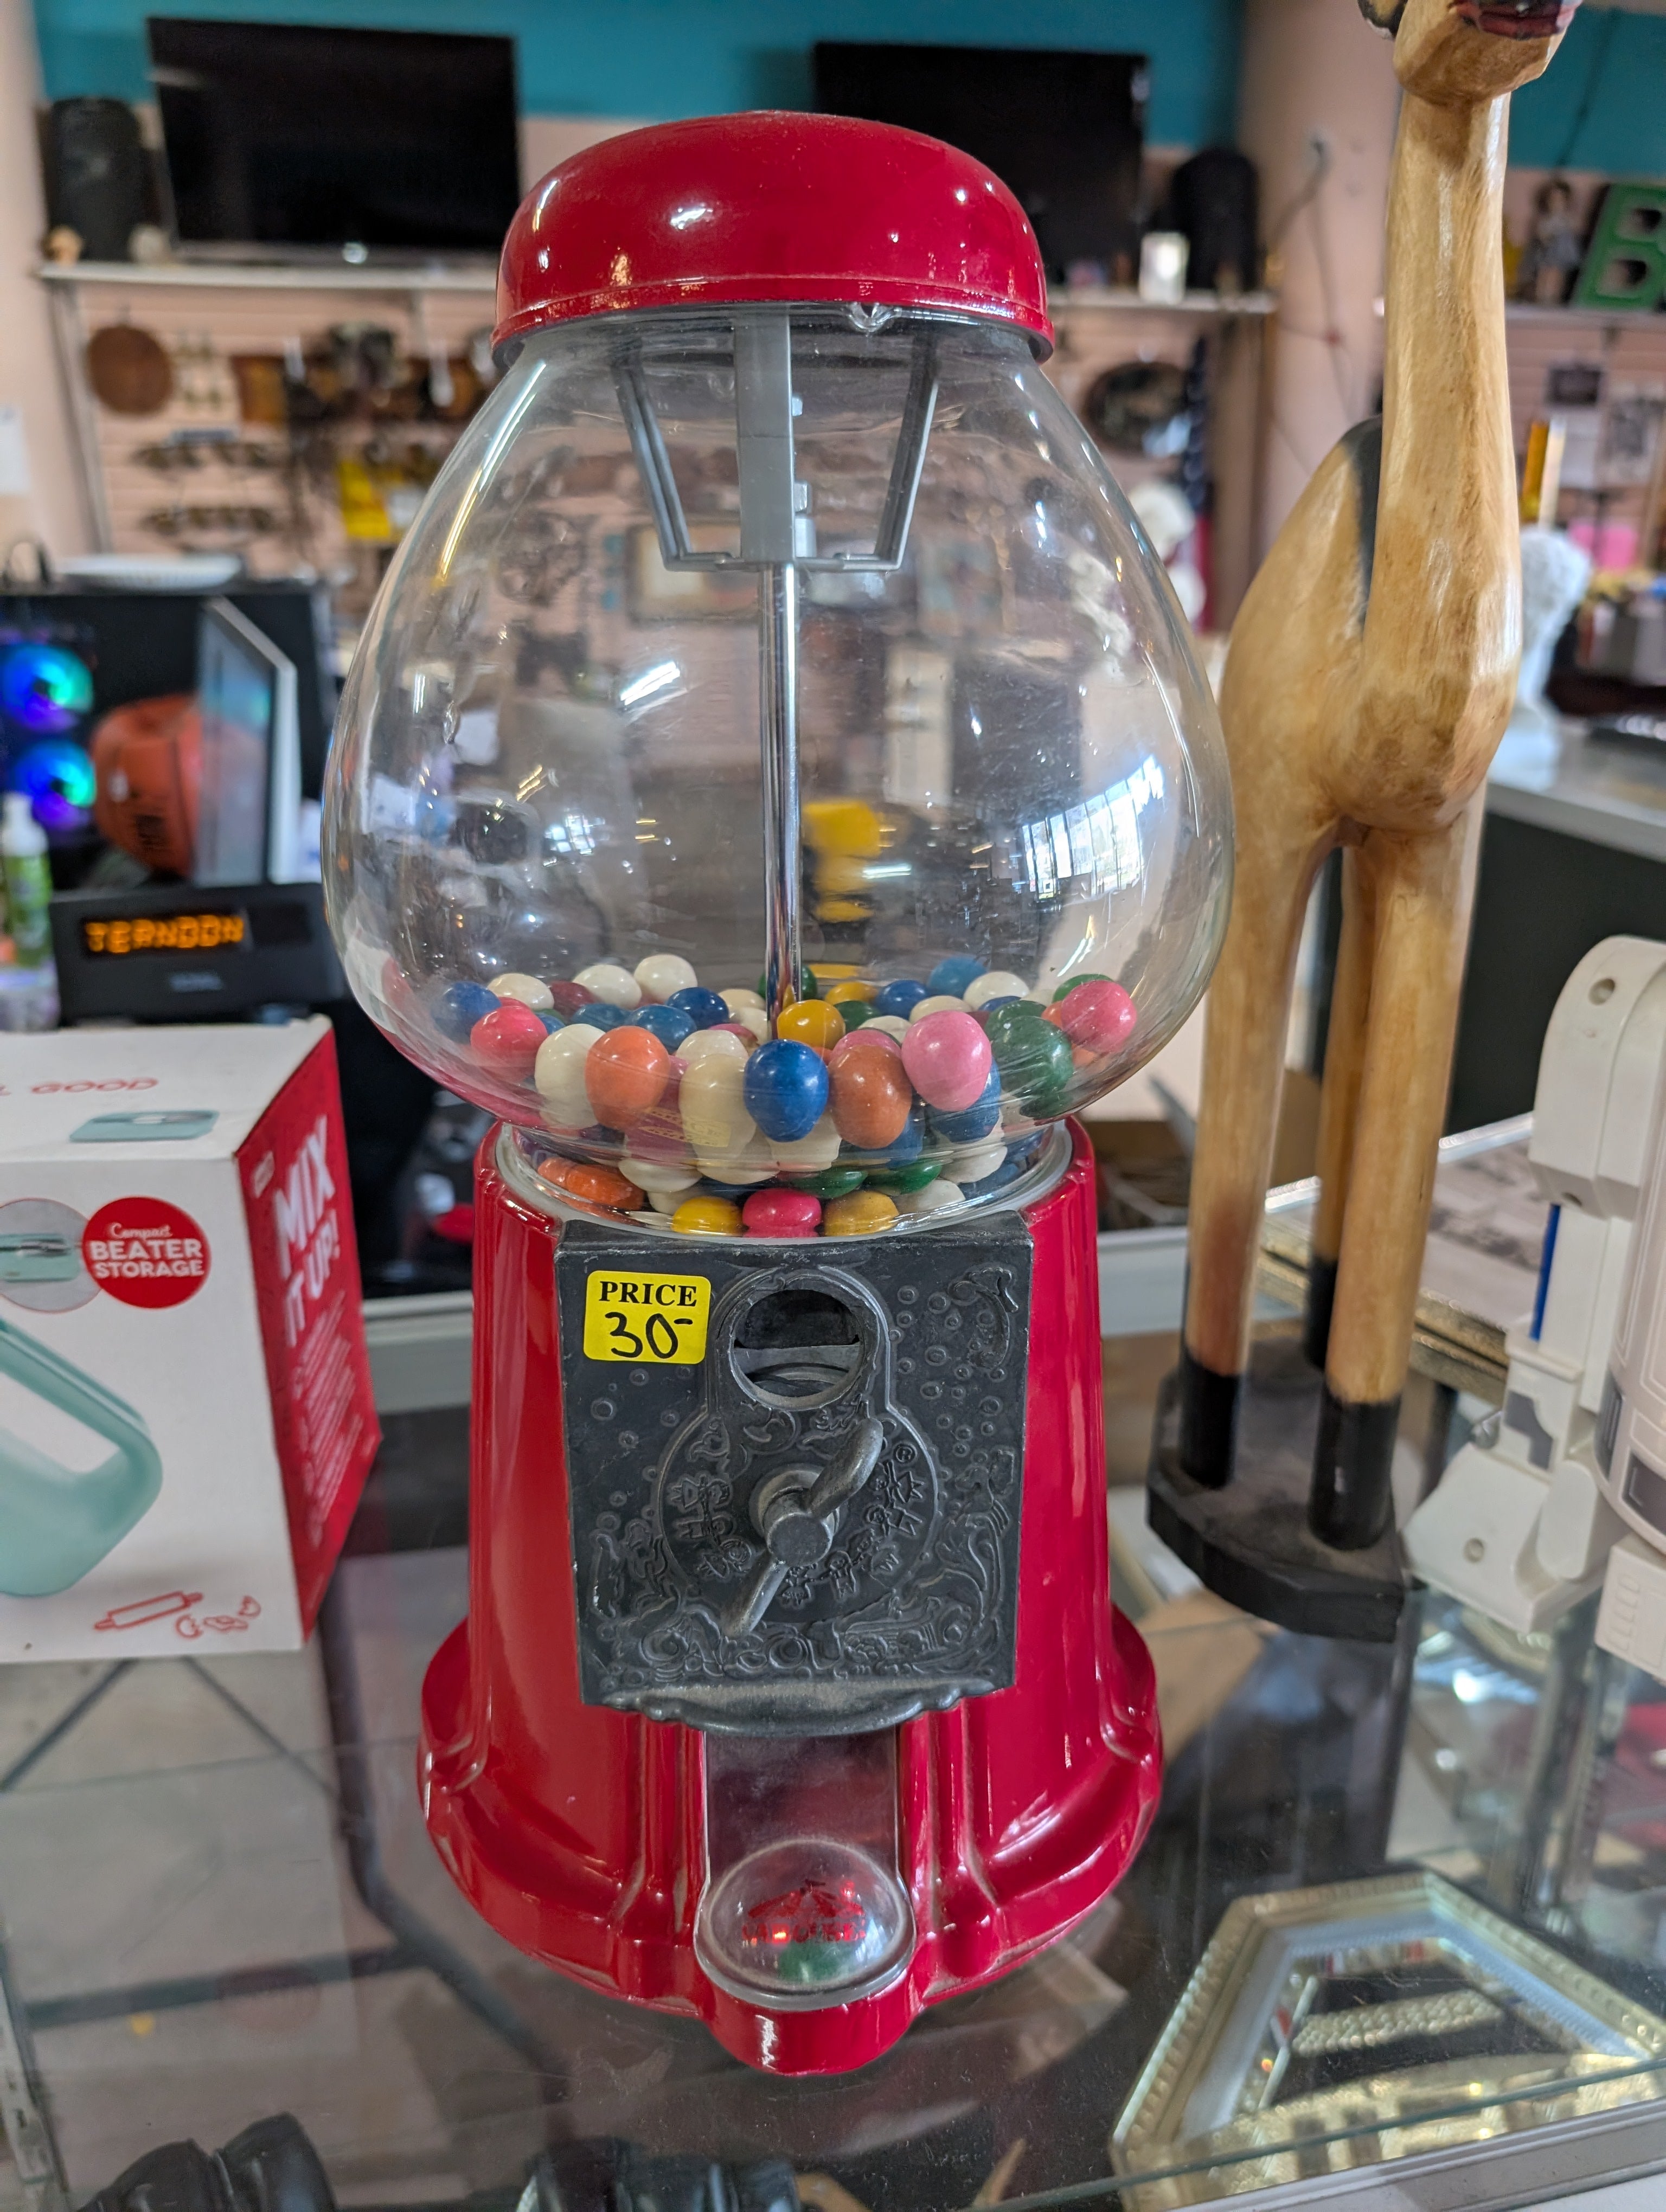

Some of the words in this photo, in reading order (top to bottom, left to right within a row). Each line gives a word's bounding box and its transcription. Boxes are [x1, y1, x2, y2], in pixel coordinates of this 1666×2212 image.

[31, 1077, 158, 1094] GOOD
[275, 1115, 335, 1281] MIX
[110, 1223, 174, 1242] Compact
[90, 1238, 203, 1261] BEATER
[94, 1259, 205, 1279] STORAGE
[599, 1281, 697, 1307] PRICE
